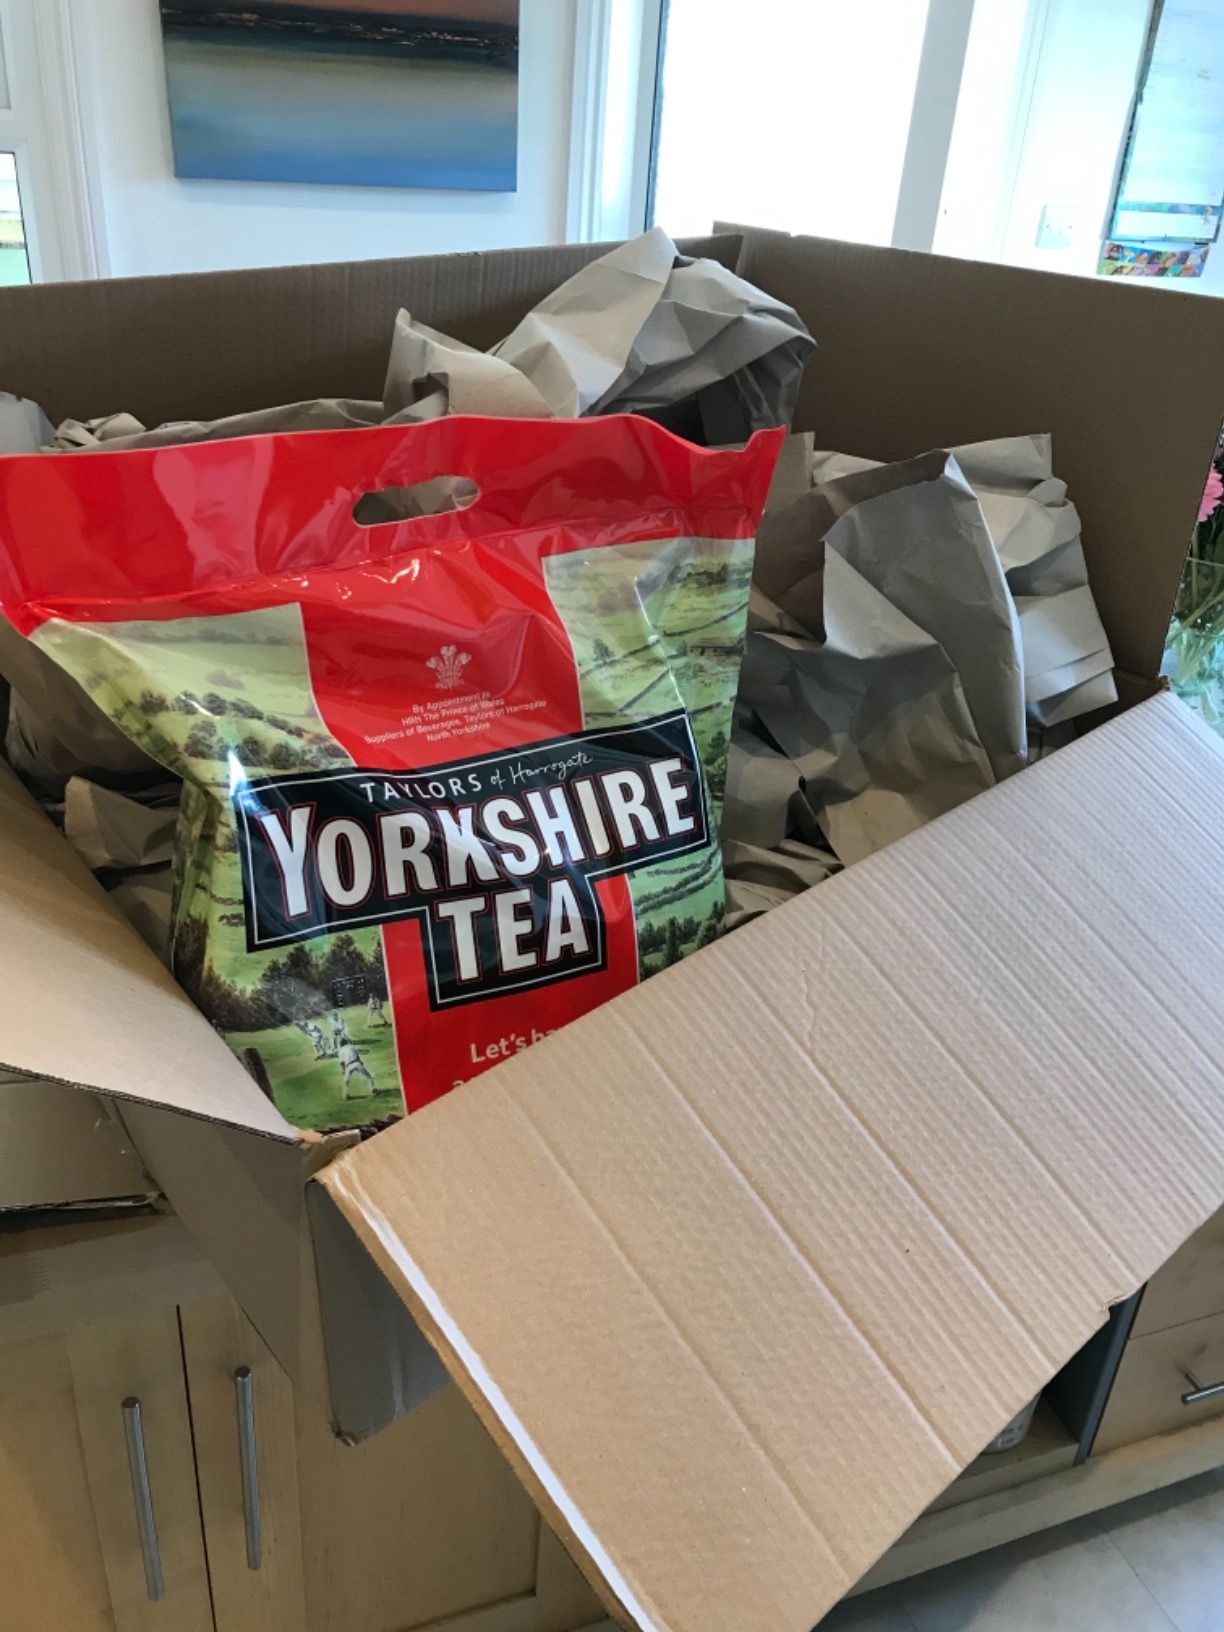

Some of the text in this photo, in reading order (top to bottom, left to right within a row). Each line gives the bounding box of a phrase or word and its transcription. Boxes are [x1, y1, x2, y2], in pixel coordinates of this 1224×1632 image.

[402, 699, 505, 726] HRH The Prince of Wales
[413, 704, 424, 714] By
[426, 693, 480, 711] Appointment
[364, 731, 404, 744] Suppliers
[406, 727, 414, 736] of
[463, 711, 495, 723] Taylors
[427, 722, 490, 742] North Yorkshire
[361, 751, 594, 803] TAYLORS of Harrogate
[258, 756, 695, 919] YORKSHIRE
[437, 876, 592, 983] TEA
[470, 1033, 527, 1063] Let's
